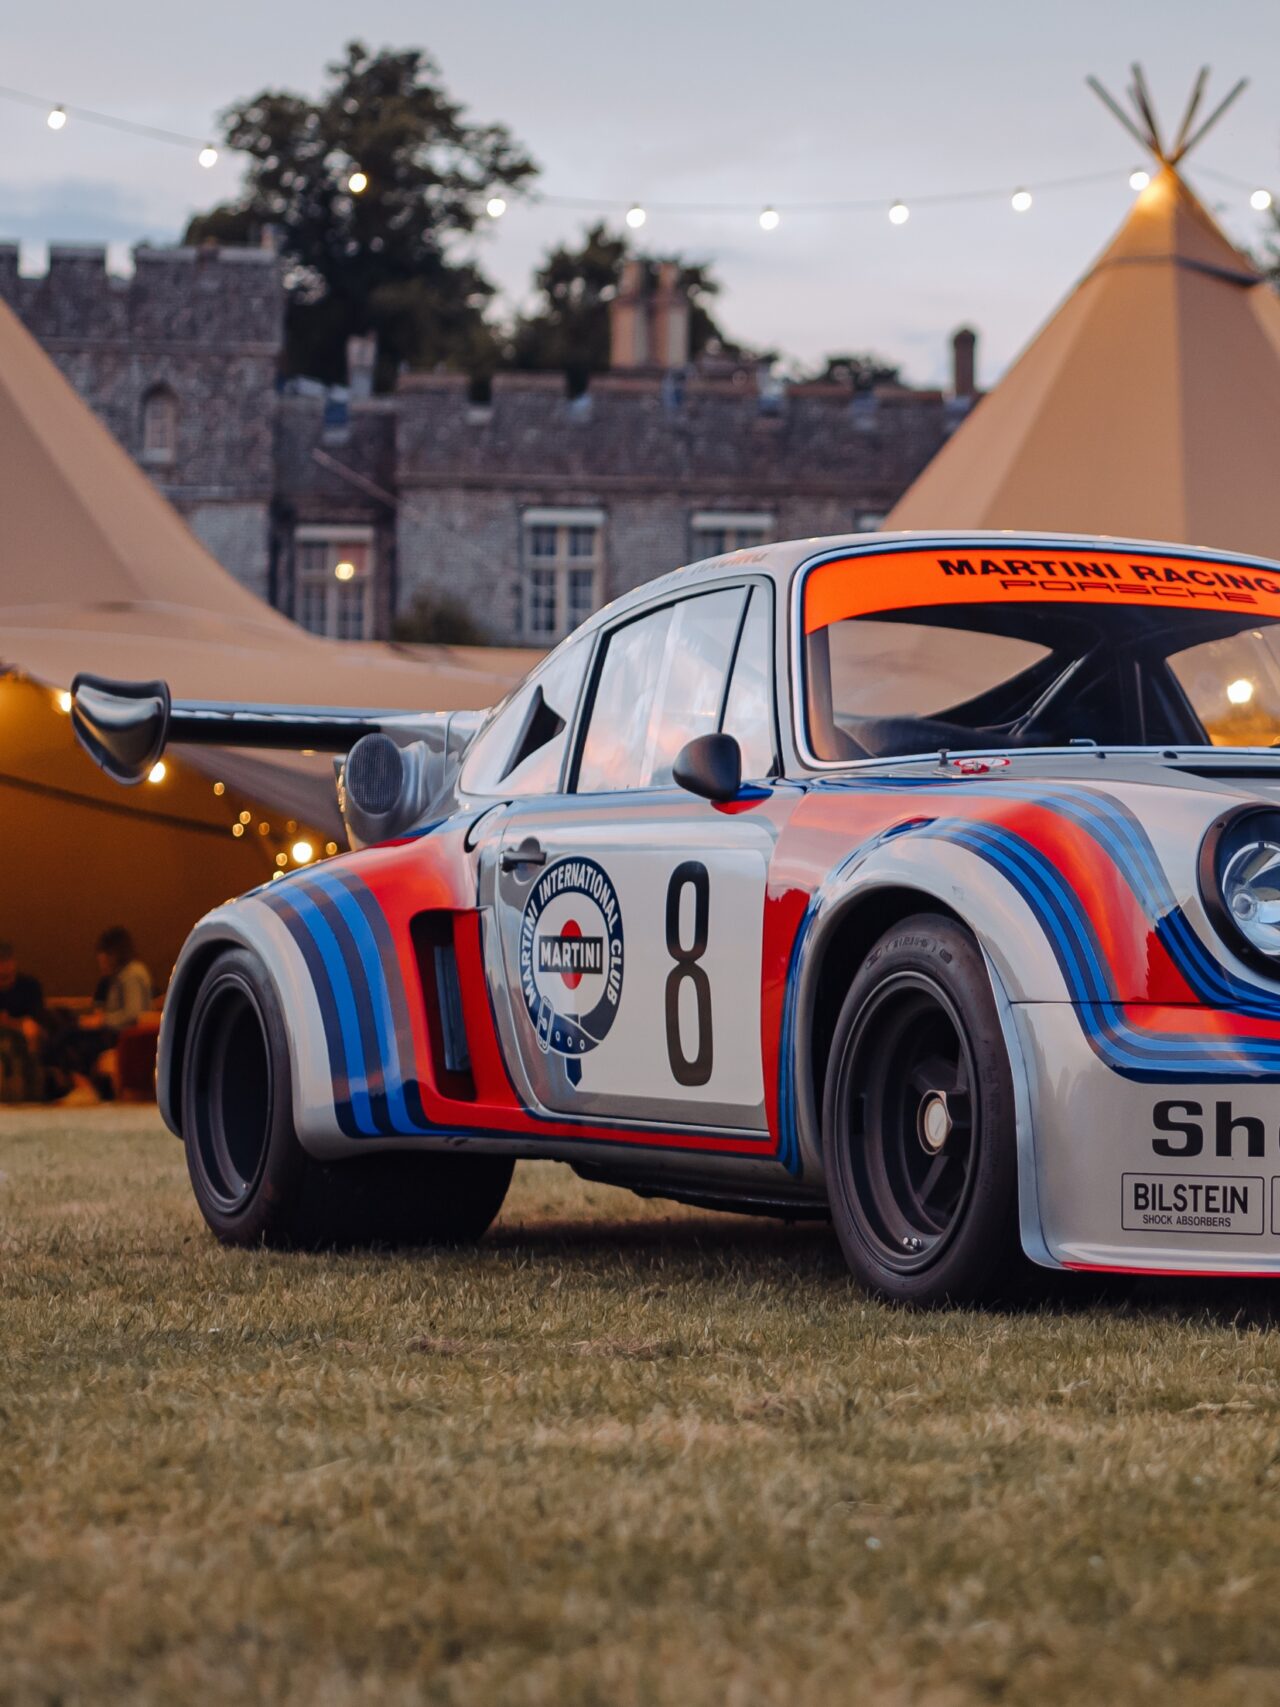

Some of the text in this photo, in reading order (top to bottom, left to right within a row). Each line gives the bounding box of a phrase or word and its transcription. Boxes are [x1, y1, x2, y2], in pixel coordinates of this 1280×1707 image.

[937, 559, 1121, 579] MARTINI
[1000, 579, 1258, 604] PORSCHE
[520, 862, 623, 1007] MARTINI INTERNATIONAL CLUB
[540, 941, 602, 969] MARTINI
[665, 860, 714, 1087] 8
[1134, 1182, 1249, 1215] BILSTEIN
[1142, 1214, 1232, 1228] SHOCK ABSORBERS
